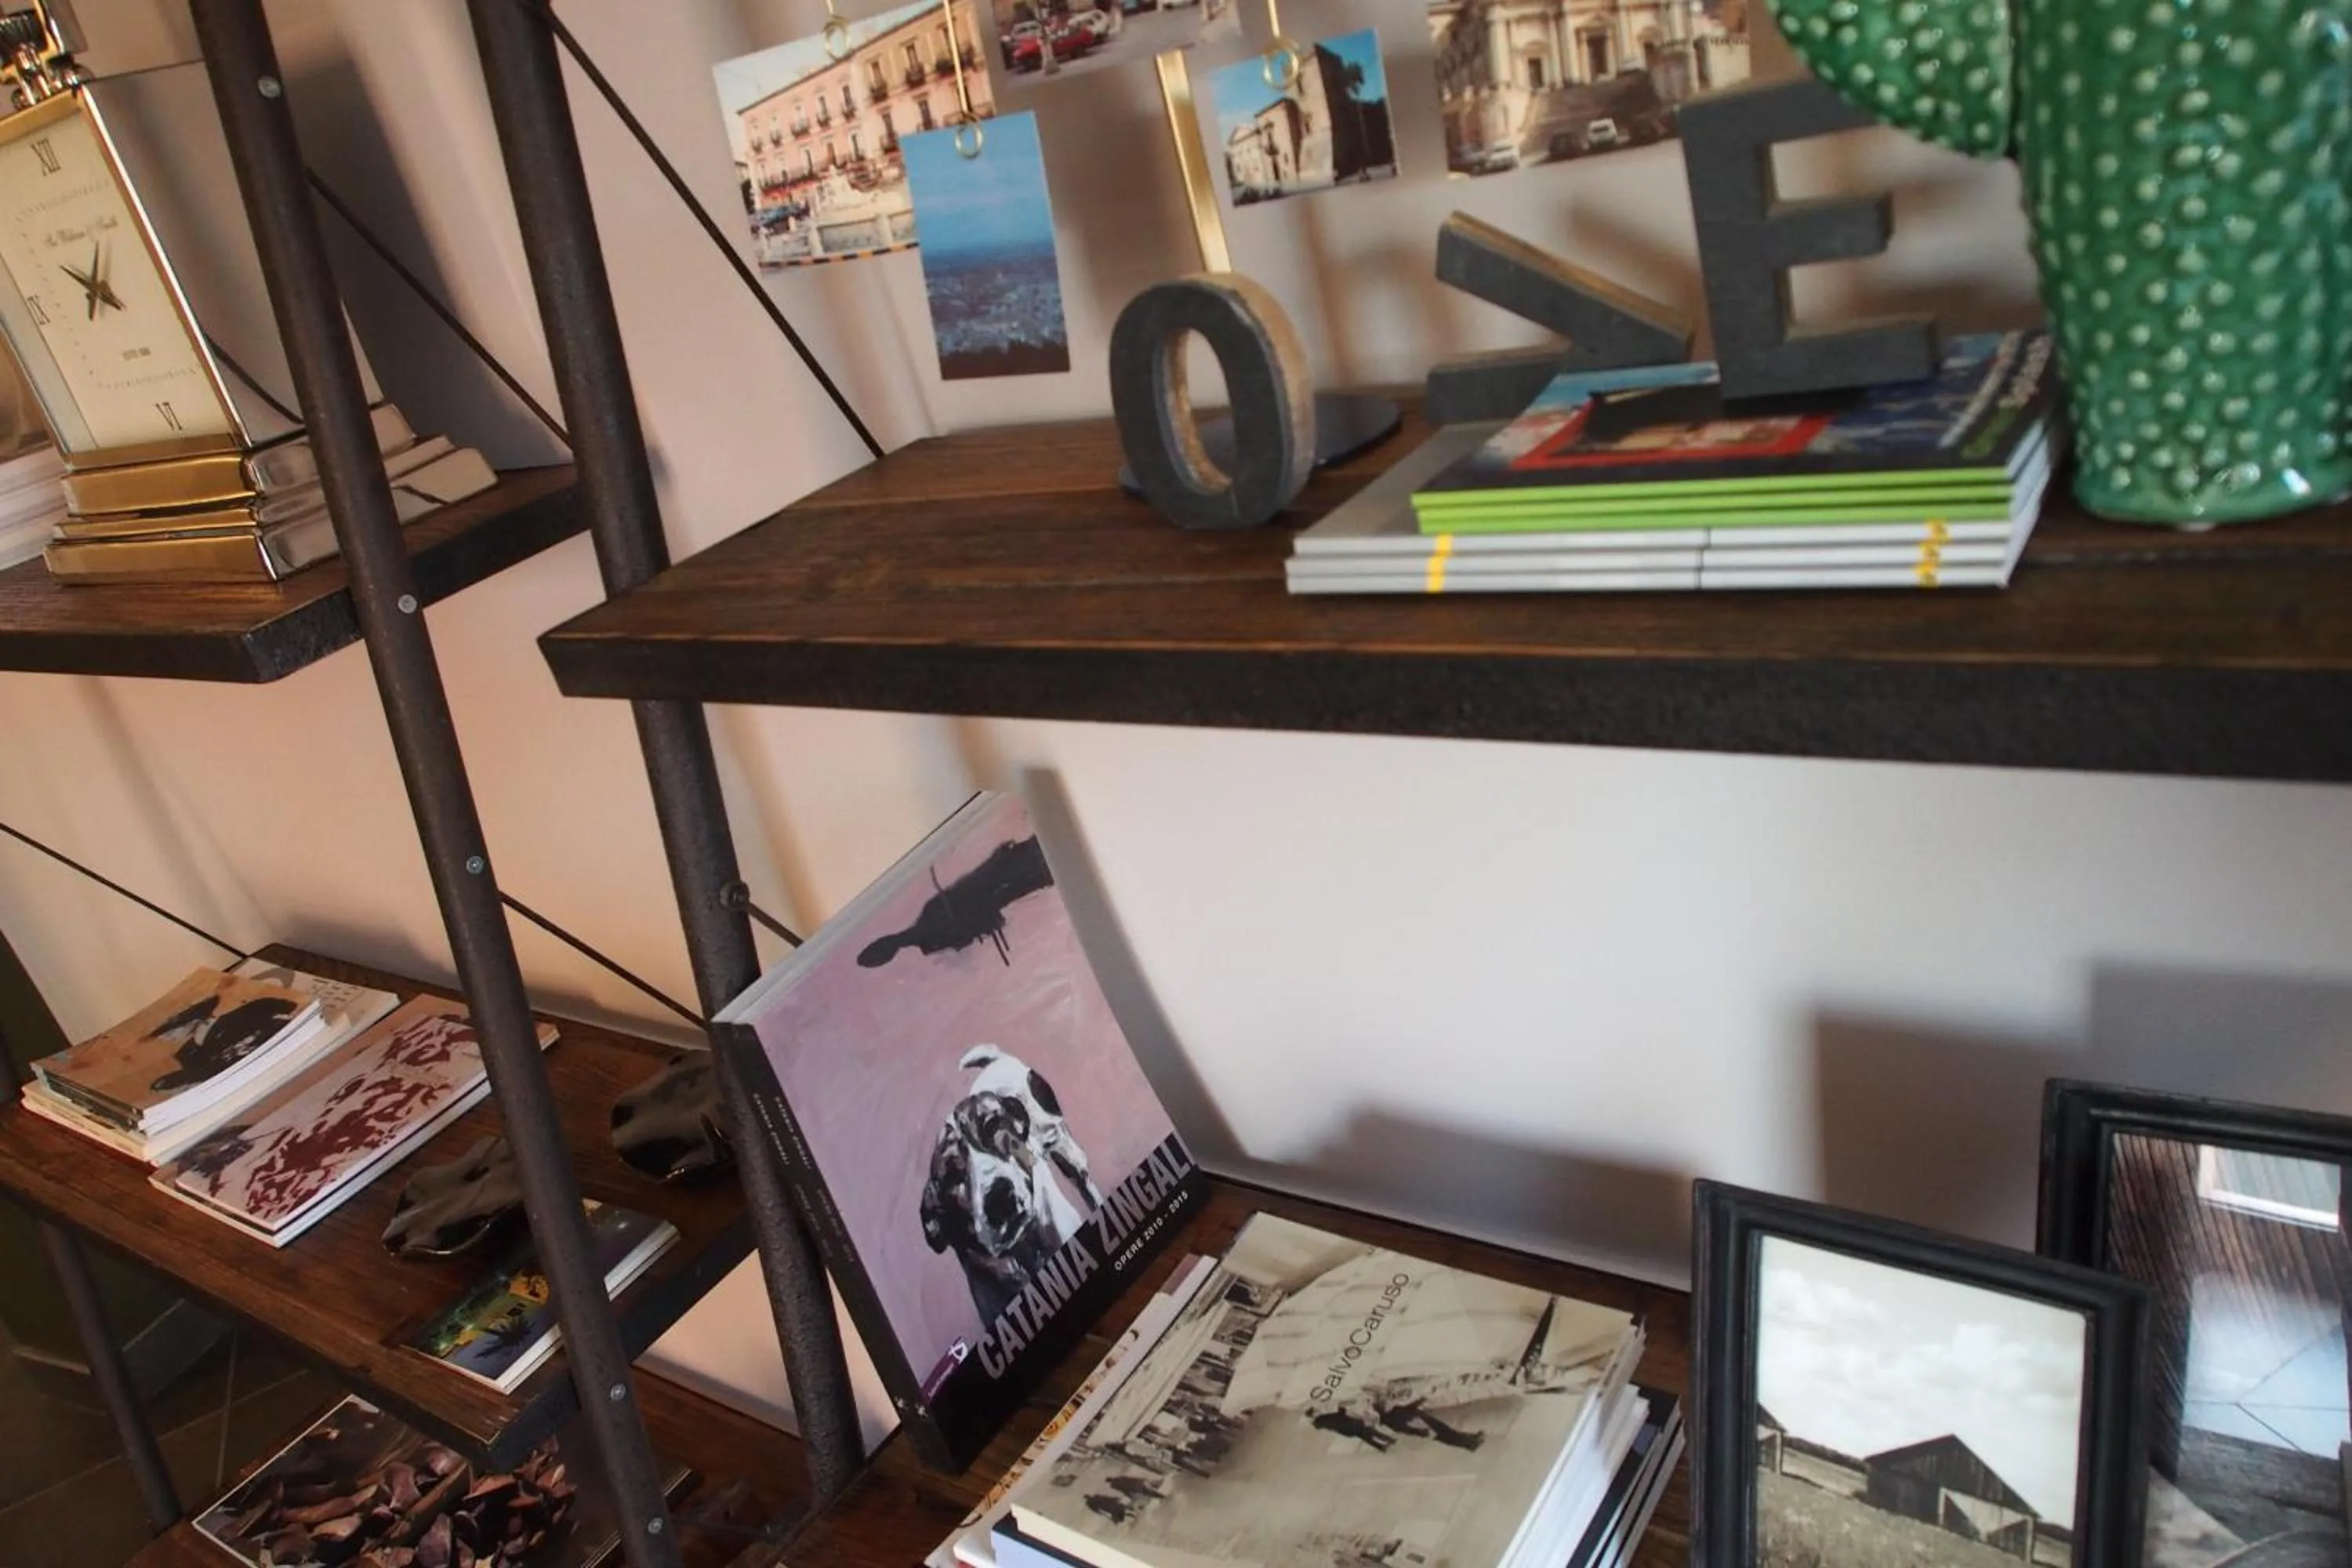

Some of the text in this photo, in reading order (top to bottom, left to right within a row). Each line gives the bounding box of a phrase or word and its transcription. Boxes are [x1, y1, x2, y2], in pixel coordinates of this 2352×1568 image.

[1680, 76, 1941, 401] E
[977, 1129, 1196, 1380] CATANIA ZINGALI
[1114, 1238, 1144, 1271] OPERE
[1143, 1216, 1164, 1241] 2010
[1168, 1190, 1189, 1214] 2015
[1309, 1272, 1410, 1403] SalvoCaruso
